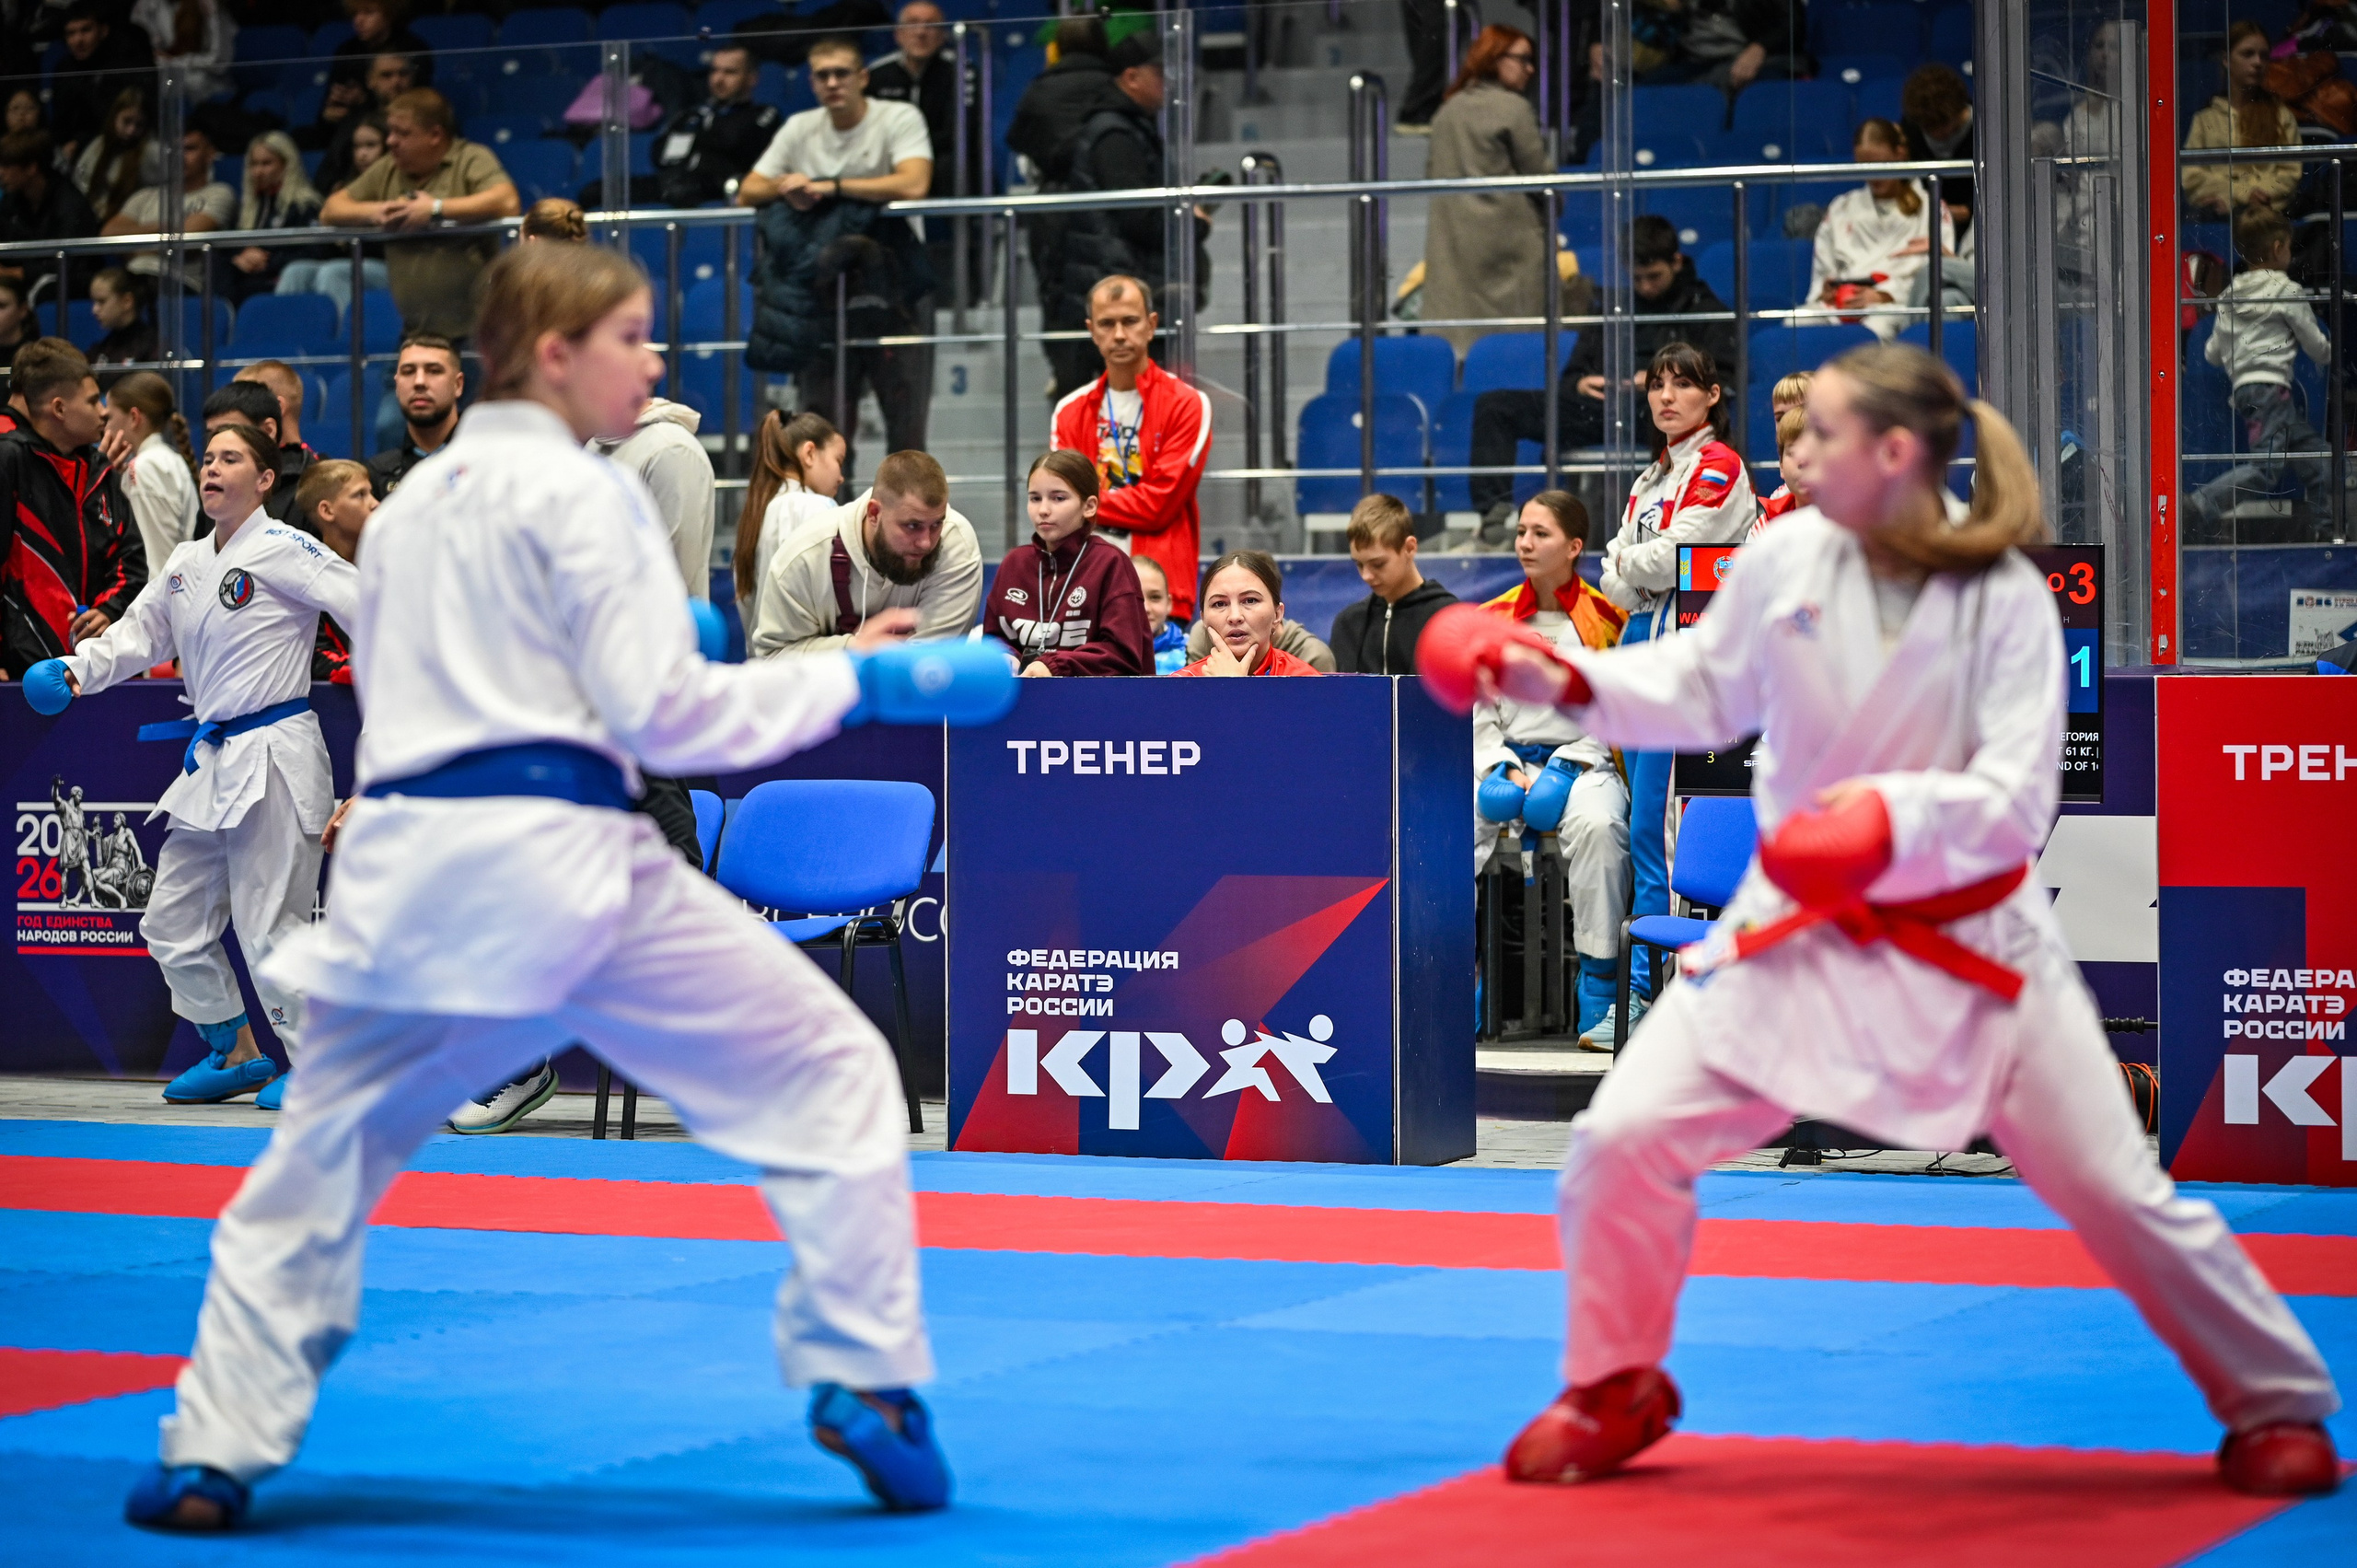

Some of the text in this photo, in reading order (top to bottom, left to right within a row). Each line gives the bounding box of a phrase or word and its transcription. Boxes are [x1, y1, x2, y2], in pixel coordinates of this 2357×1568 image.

[289, 533, 322, 558] SPORT
[2068, 562, 2096, 605] 3
[2071, 645, 2090, 688] 1
[2060, 732, 2099, 742] ЕГОРИЯ
[1007, 740, 1201, 775] ТРЕНЕР
[1706, 750, 1715, 763] 3
[2065, 747, 2077, 756] 61
[2074, 761, 2088, 771] OF
[2223, 745, 2357, 781] ТРЕН
[17, 813, 64, 857] 20
[17, 856, 62, 900] 26
[17, 915, 113, 929] ГОД ЕДИНСТВА
[17, 929, 134, 943] НАРОДОВ РОССИИ
[1007, 948, 1179, 971] ФЕДЕРАЦИЯ
[1007, 972, 1114, 993] КАРАТЭ
[1007, 996, 1114, 1016] РОССИИ
[2223, 993, 2345, 1015] КАРАТЭ
[2223, 1019, 2345, 1040] РОССИИ
